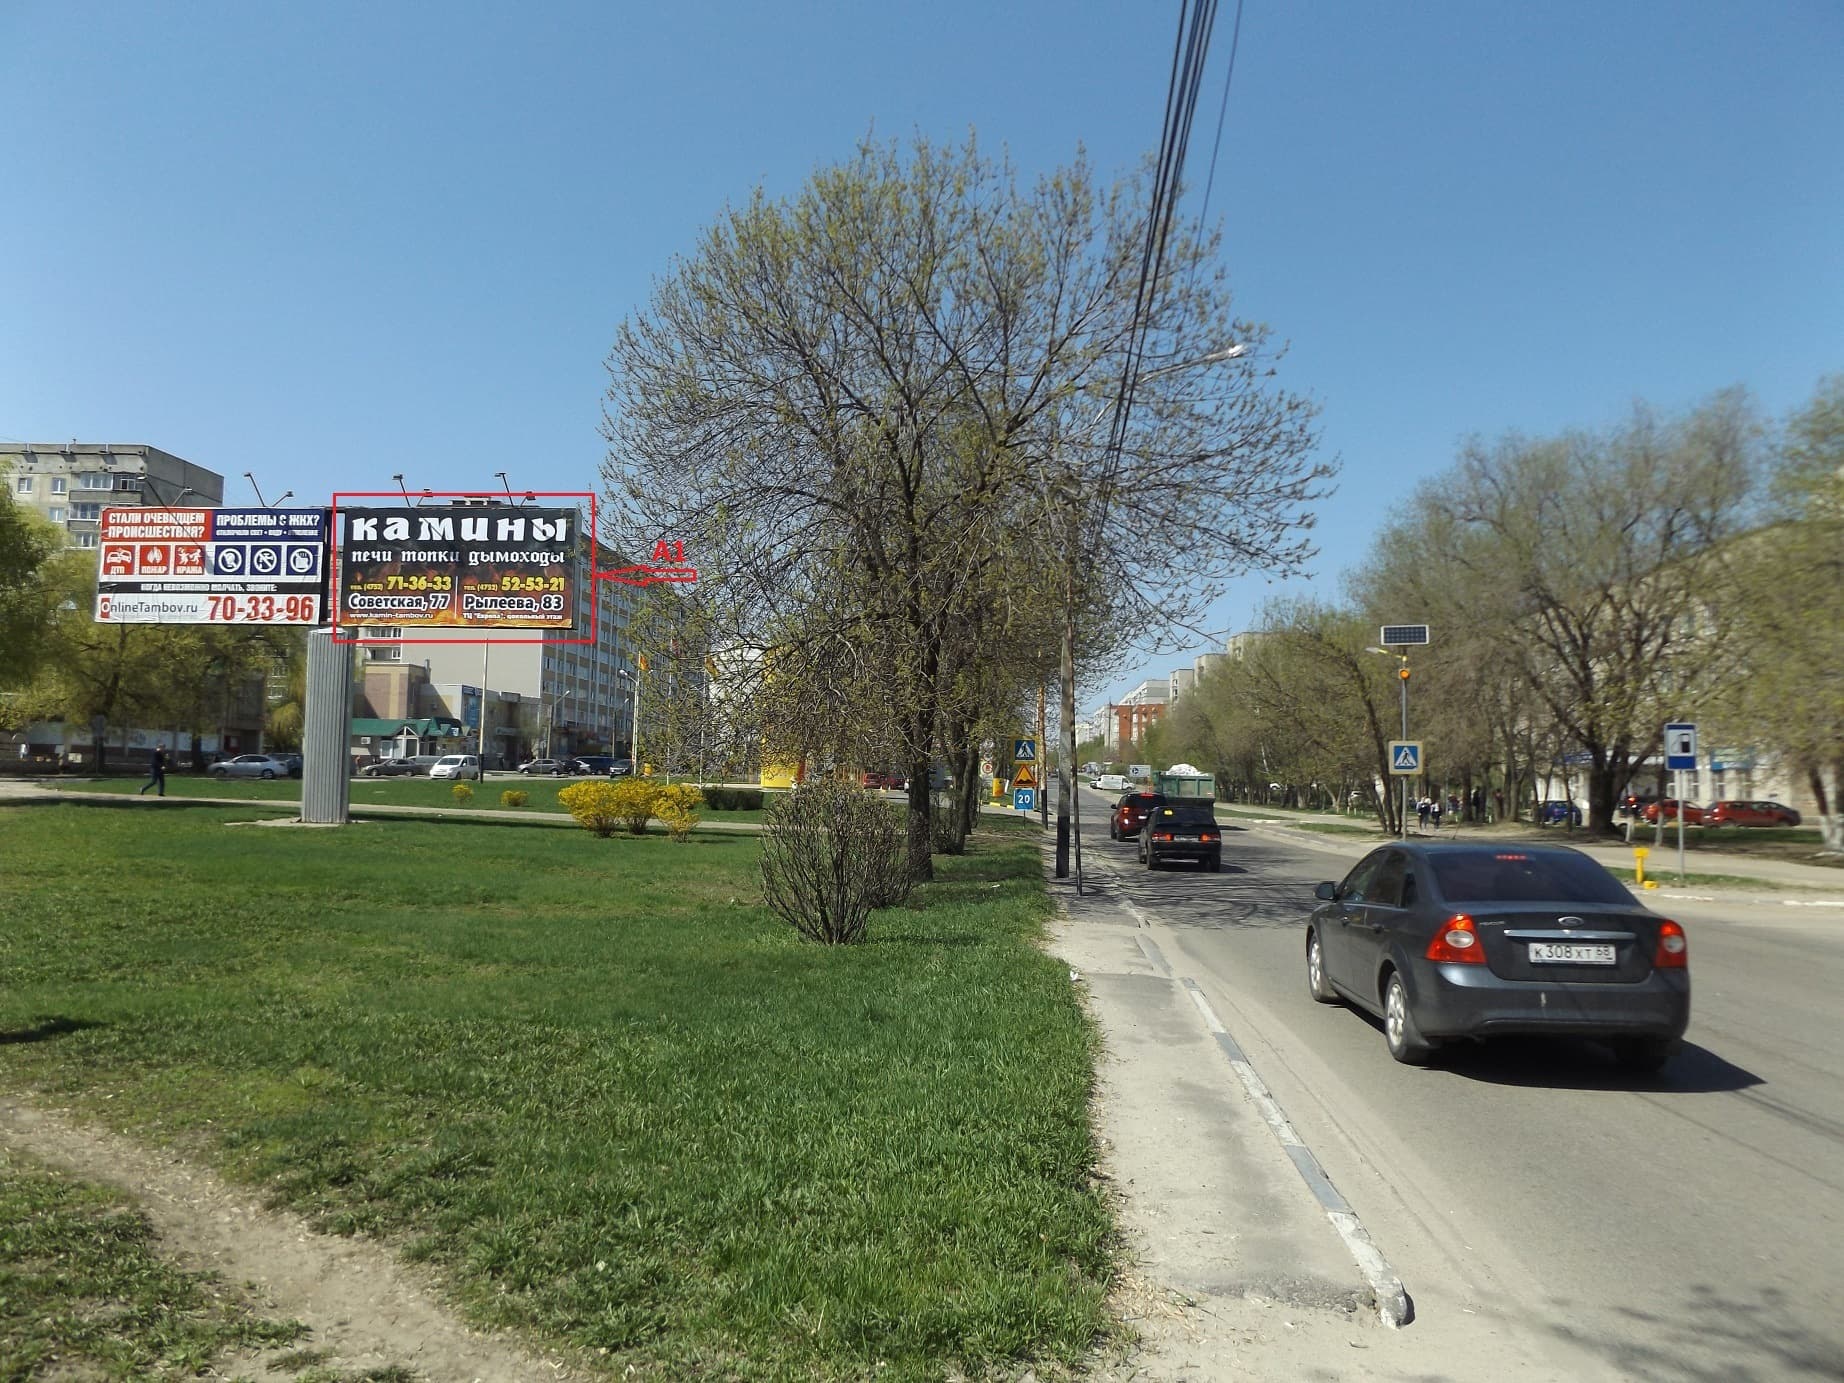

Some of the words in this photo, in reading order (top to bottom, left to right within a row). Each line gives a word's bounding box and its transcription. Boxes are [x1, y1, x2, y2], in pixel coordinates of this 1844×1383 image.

[109, 513, 141, 524] СТАЛИ
[144, 513, 205, 525] ОЧЕВИДЦЕМ
[216, 514, 277, 526] ПРОБЛЕМЫ
[108, 526, 205, 538] ПРОИСШЕСТВИЯ?
[352, 517, 567, 541] камины
[352, 550, 392, 562] печи
[401, 550, 460, 562] топки
[468, 551, 565, 567] дымоходы
[387, 576, 452, 591] 71-36-33
[501, 576, 565, 591] 52-53-21
[101, 601, 198, 613] OnlineTambov.ru
[208, 595, 314, 622] 70-33-96
[349, 593, 428, 611] Советская,
[429, 594, 450, 610] 77
[463, 594, 539, 612] Рылеева,
[541, 594, 564, 611] 83
[1018, 794, 1030, 804] 20
